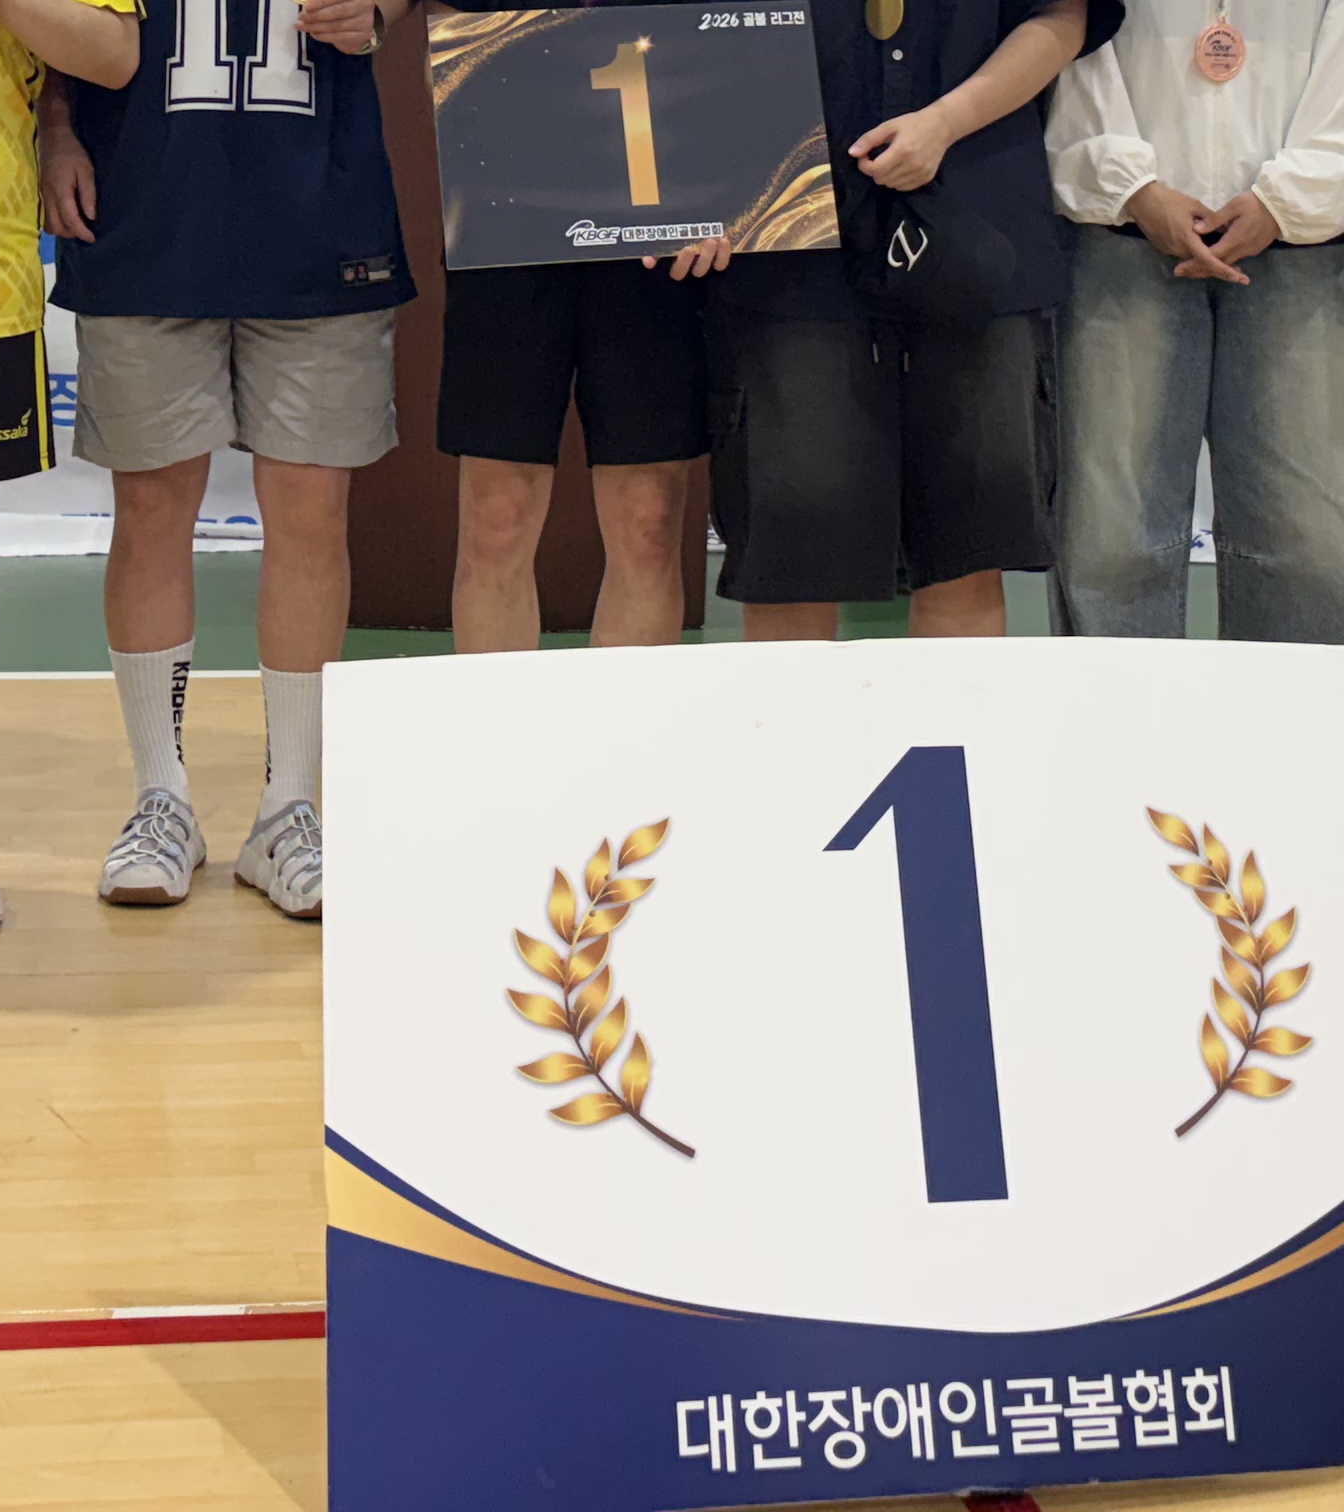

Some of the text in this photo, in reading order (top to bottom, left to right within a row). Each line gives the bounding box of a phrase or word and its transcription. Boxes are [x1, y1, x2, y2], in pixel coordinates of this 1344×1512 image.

[697, 10, 806, 30] 2026 골볼 리그전
[589, 42, 660, 207] 1
[574, 227, 621, 242] KBGF
[822, 745, 1009, 1204] 1
[675, 1366, 1237, 1473] 대한장애인골볼협회
